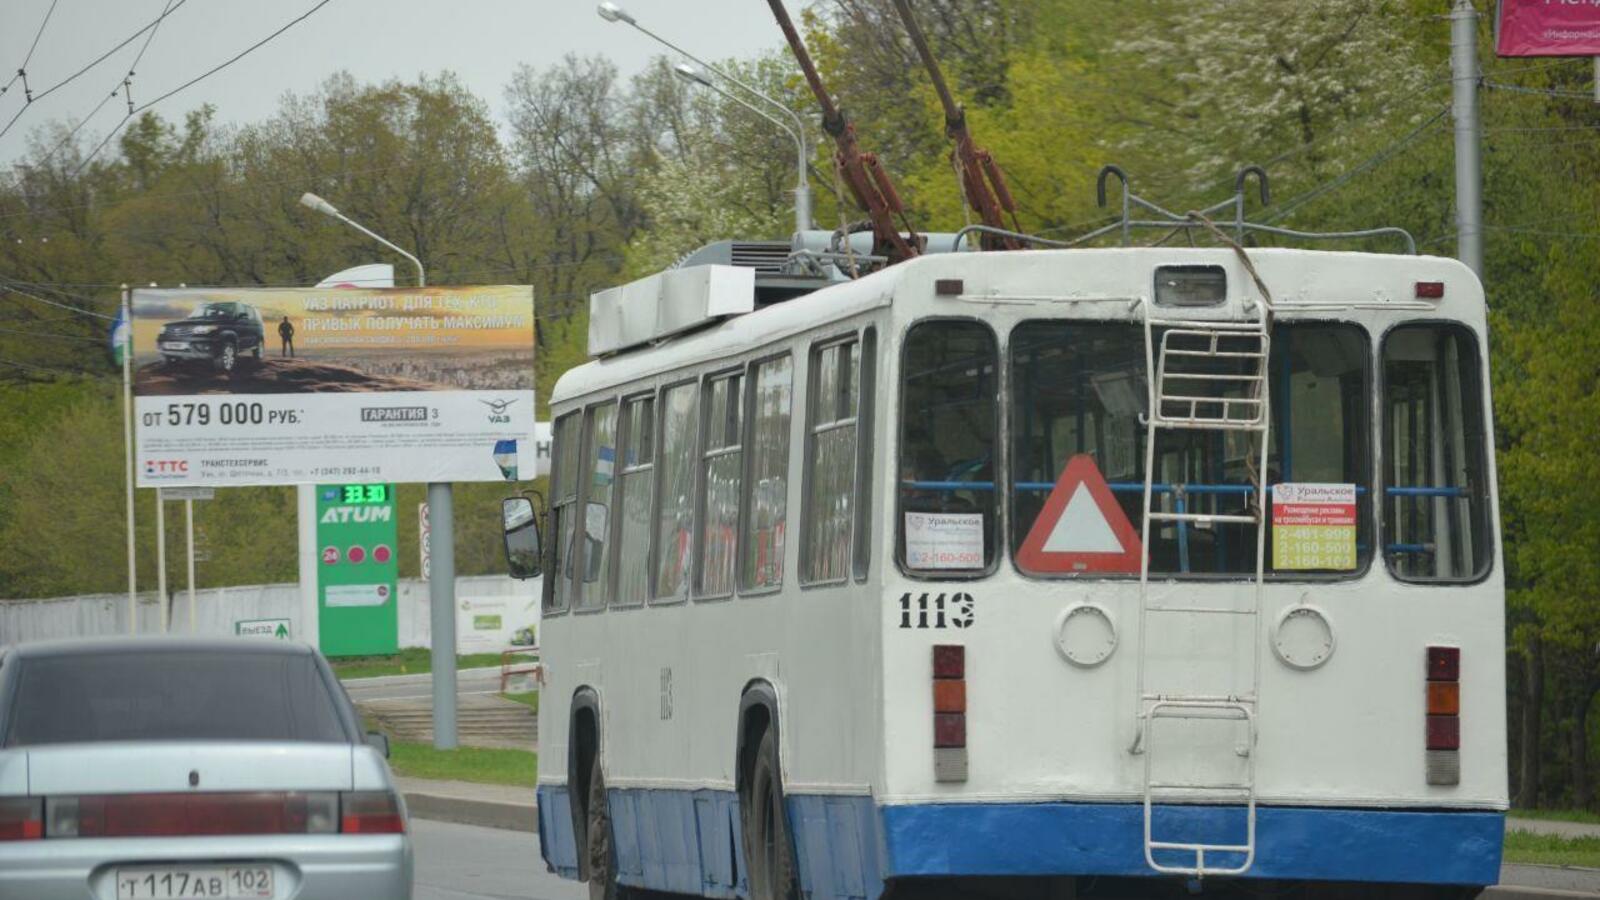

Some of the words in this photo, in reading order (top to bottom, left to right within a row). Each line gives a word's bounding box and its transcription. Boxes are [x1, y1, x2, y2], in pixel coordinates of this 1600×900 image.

[303, 296, 327, 310] УАЗ
[403, 295, 432, 311] ДЛЯ
[303, 317, 361, 331] ПРИВЫК
[366, 316, 438, 330] ПОЛУЧАТЬ
[444, 315, 525, 329] МАКСИМУМ
[143, 412, 162, 427] ОТ
[168, 403, 211, 426] 579
[220, 402, 263, 425] 000
[363, 408, 425, 420] ГАРАНТИЯ
[432, 408, 438, 419] 3
[159, 460, 188, 472] ТТС
[1297, 487, 1353, 496] Уральское
[320, 506, 391, 523] ATUM
[928, 517, 980, 527] Уральское
[899, 592, 974, 629] 1113
[126, 872, 222, 897] Т117АВ
[232, 869, 269, 889] 102
